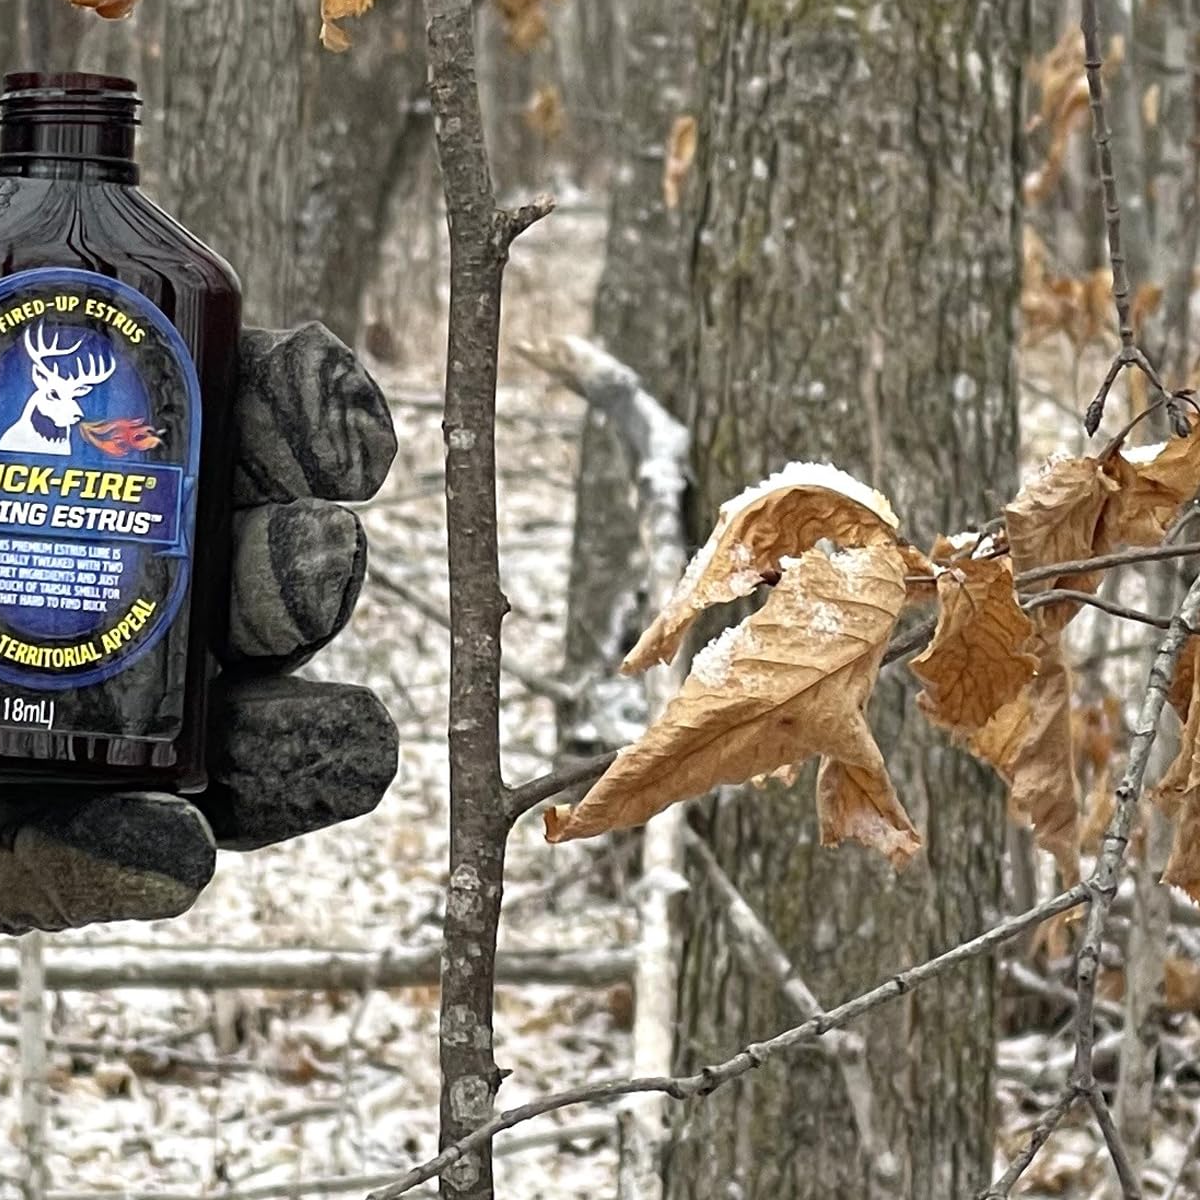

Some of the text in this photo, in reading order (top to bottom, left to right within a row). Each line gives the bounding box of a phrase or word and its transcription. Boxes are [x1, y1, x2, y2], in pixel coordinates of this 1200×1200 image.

[85, 299, 146, 344] ESTRUS
[54, 543, 87, 557] ESTRUS
[112, 548, 121, 560] IS
[77, 559, 100, 571] WITH
[102, 561, 123, 573] TWO
[77, 572, 96, 584] AND
[97, 574, 119, 586] JUST
[25, 581, 38, 593] OF
[74, 585, 101, 598] SMELL
[103, 588, 120, 600] FOR
[19, 594, 44, 607] HARD
[47, 596, 59, 608] TO
[60, 598, 81, 610] FIND
[101, 598, 157, 654] APPEAL
